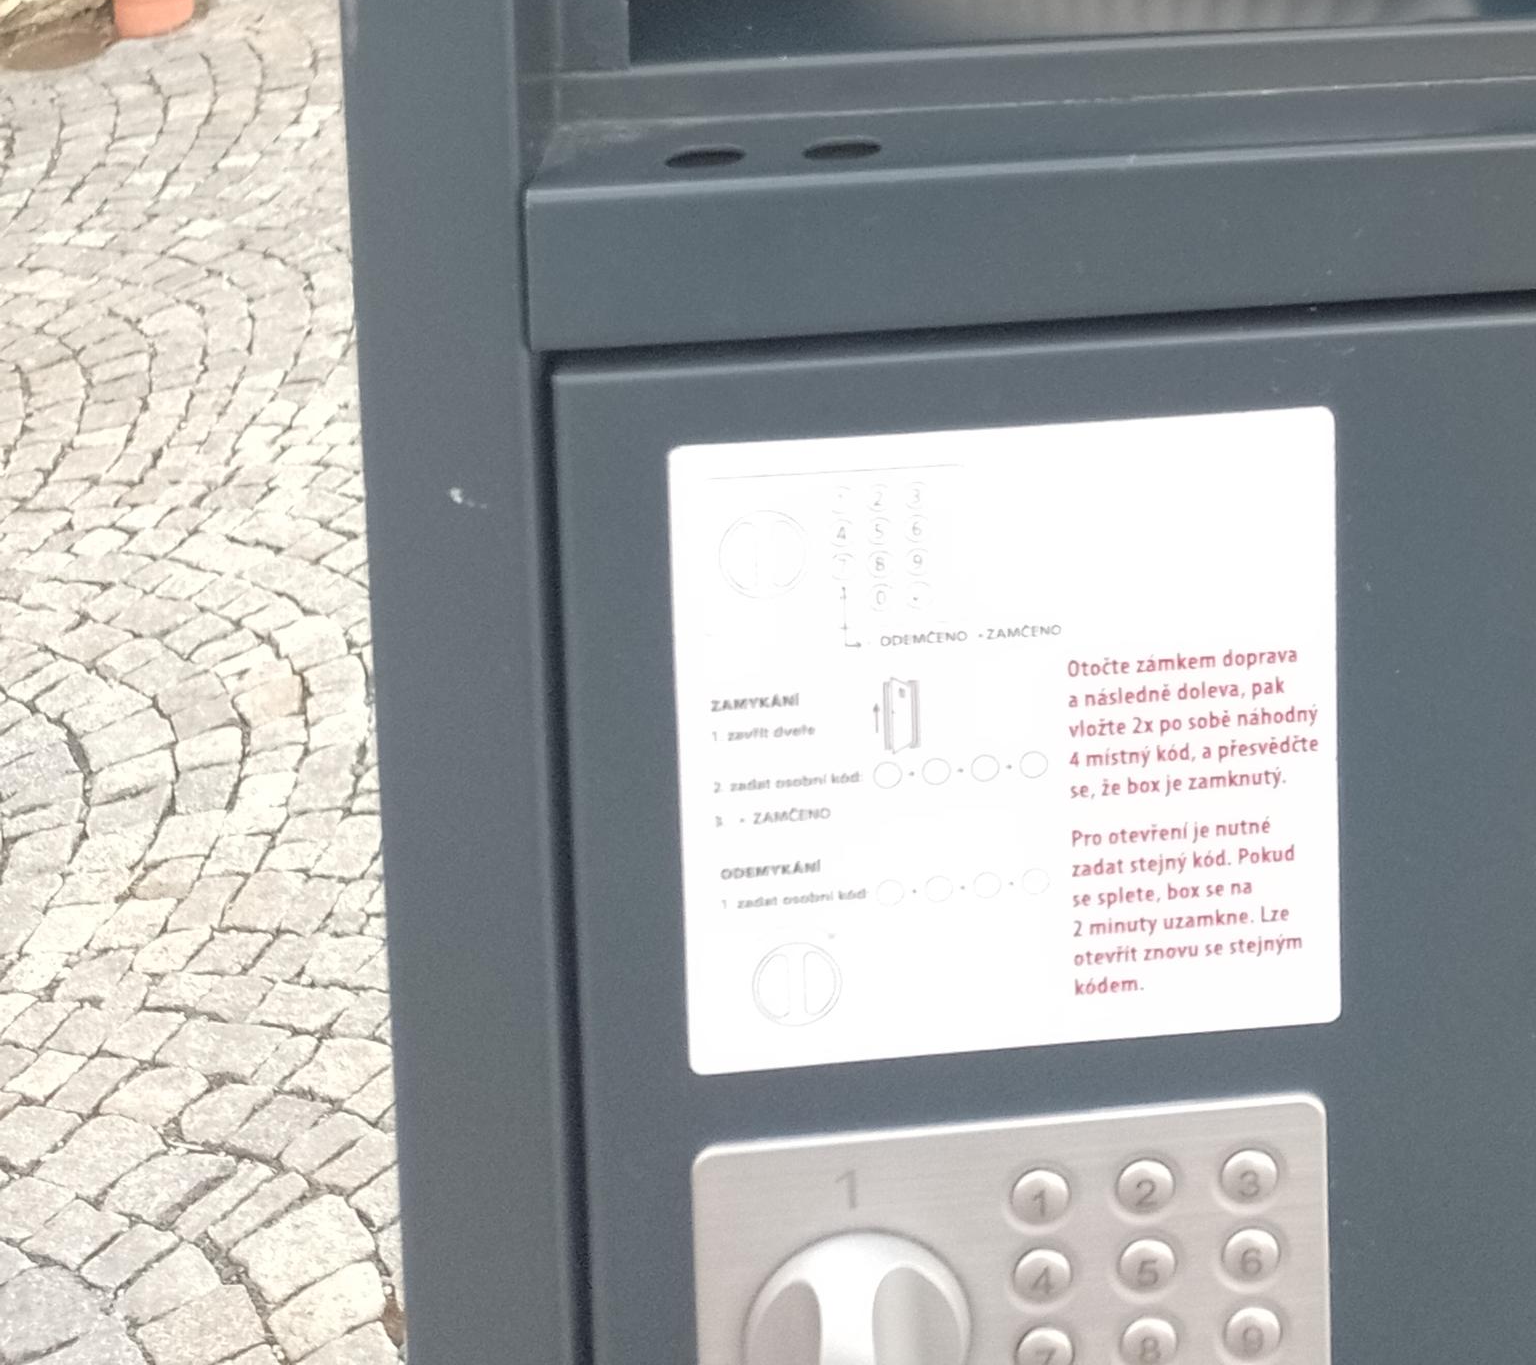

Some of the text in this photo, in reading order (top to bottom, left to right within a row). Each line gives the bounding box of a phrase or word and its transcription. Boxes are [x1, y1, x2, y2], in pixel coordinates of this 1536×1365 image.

[912, 521, 922, 536] 6
[1068, 649, 1297, 677] Otočte zámkem doprava
[710, 693, 799, 713] ZAMYKÁNÍ
[1069, 677, 1284, 708] a následně doleva, pak
[1069, 704, 1318, 737] vložte 2x po sobě náhodný
[1069, 735, 1318, 768] 4 místný kód, a přesvědčte
[1071, 767, 1286, 798] se, že box je zamknutý.
[1072, 817, 1270, 846] Pro otevření je nutné
[720, 859, 821, 880] ODEMYKÁNÍ
[1072, 844, 1294, 877] zadat stejný kód. Pokud
[1073, 882, 1252, 909] se splete, box se na
[1074, 906, 1289, 937] 2 minuty uzamkne. Lze
[1074, 934, 1302, 966] otevřít znovu se stejným
[1075, 977, 1144, 995] kódem.
[834, 1168, 860, 1211] 1
[1030, 1171, 1260, 1217] 1 2 3
[1032, 1248, 1262, 1294] 4 5 6
[1140, 1337, 1161, 1364] 8
